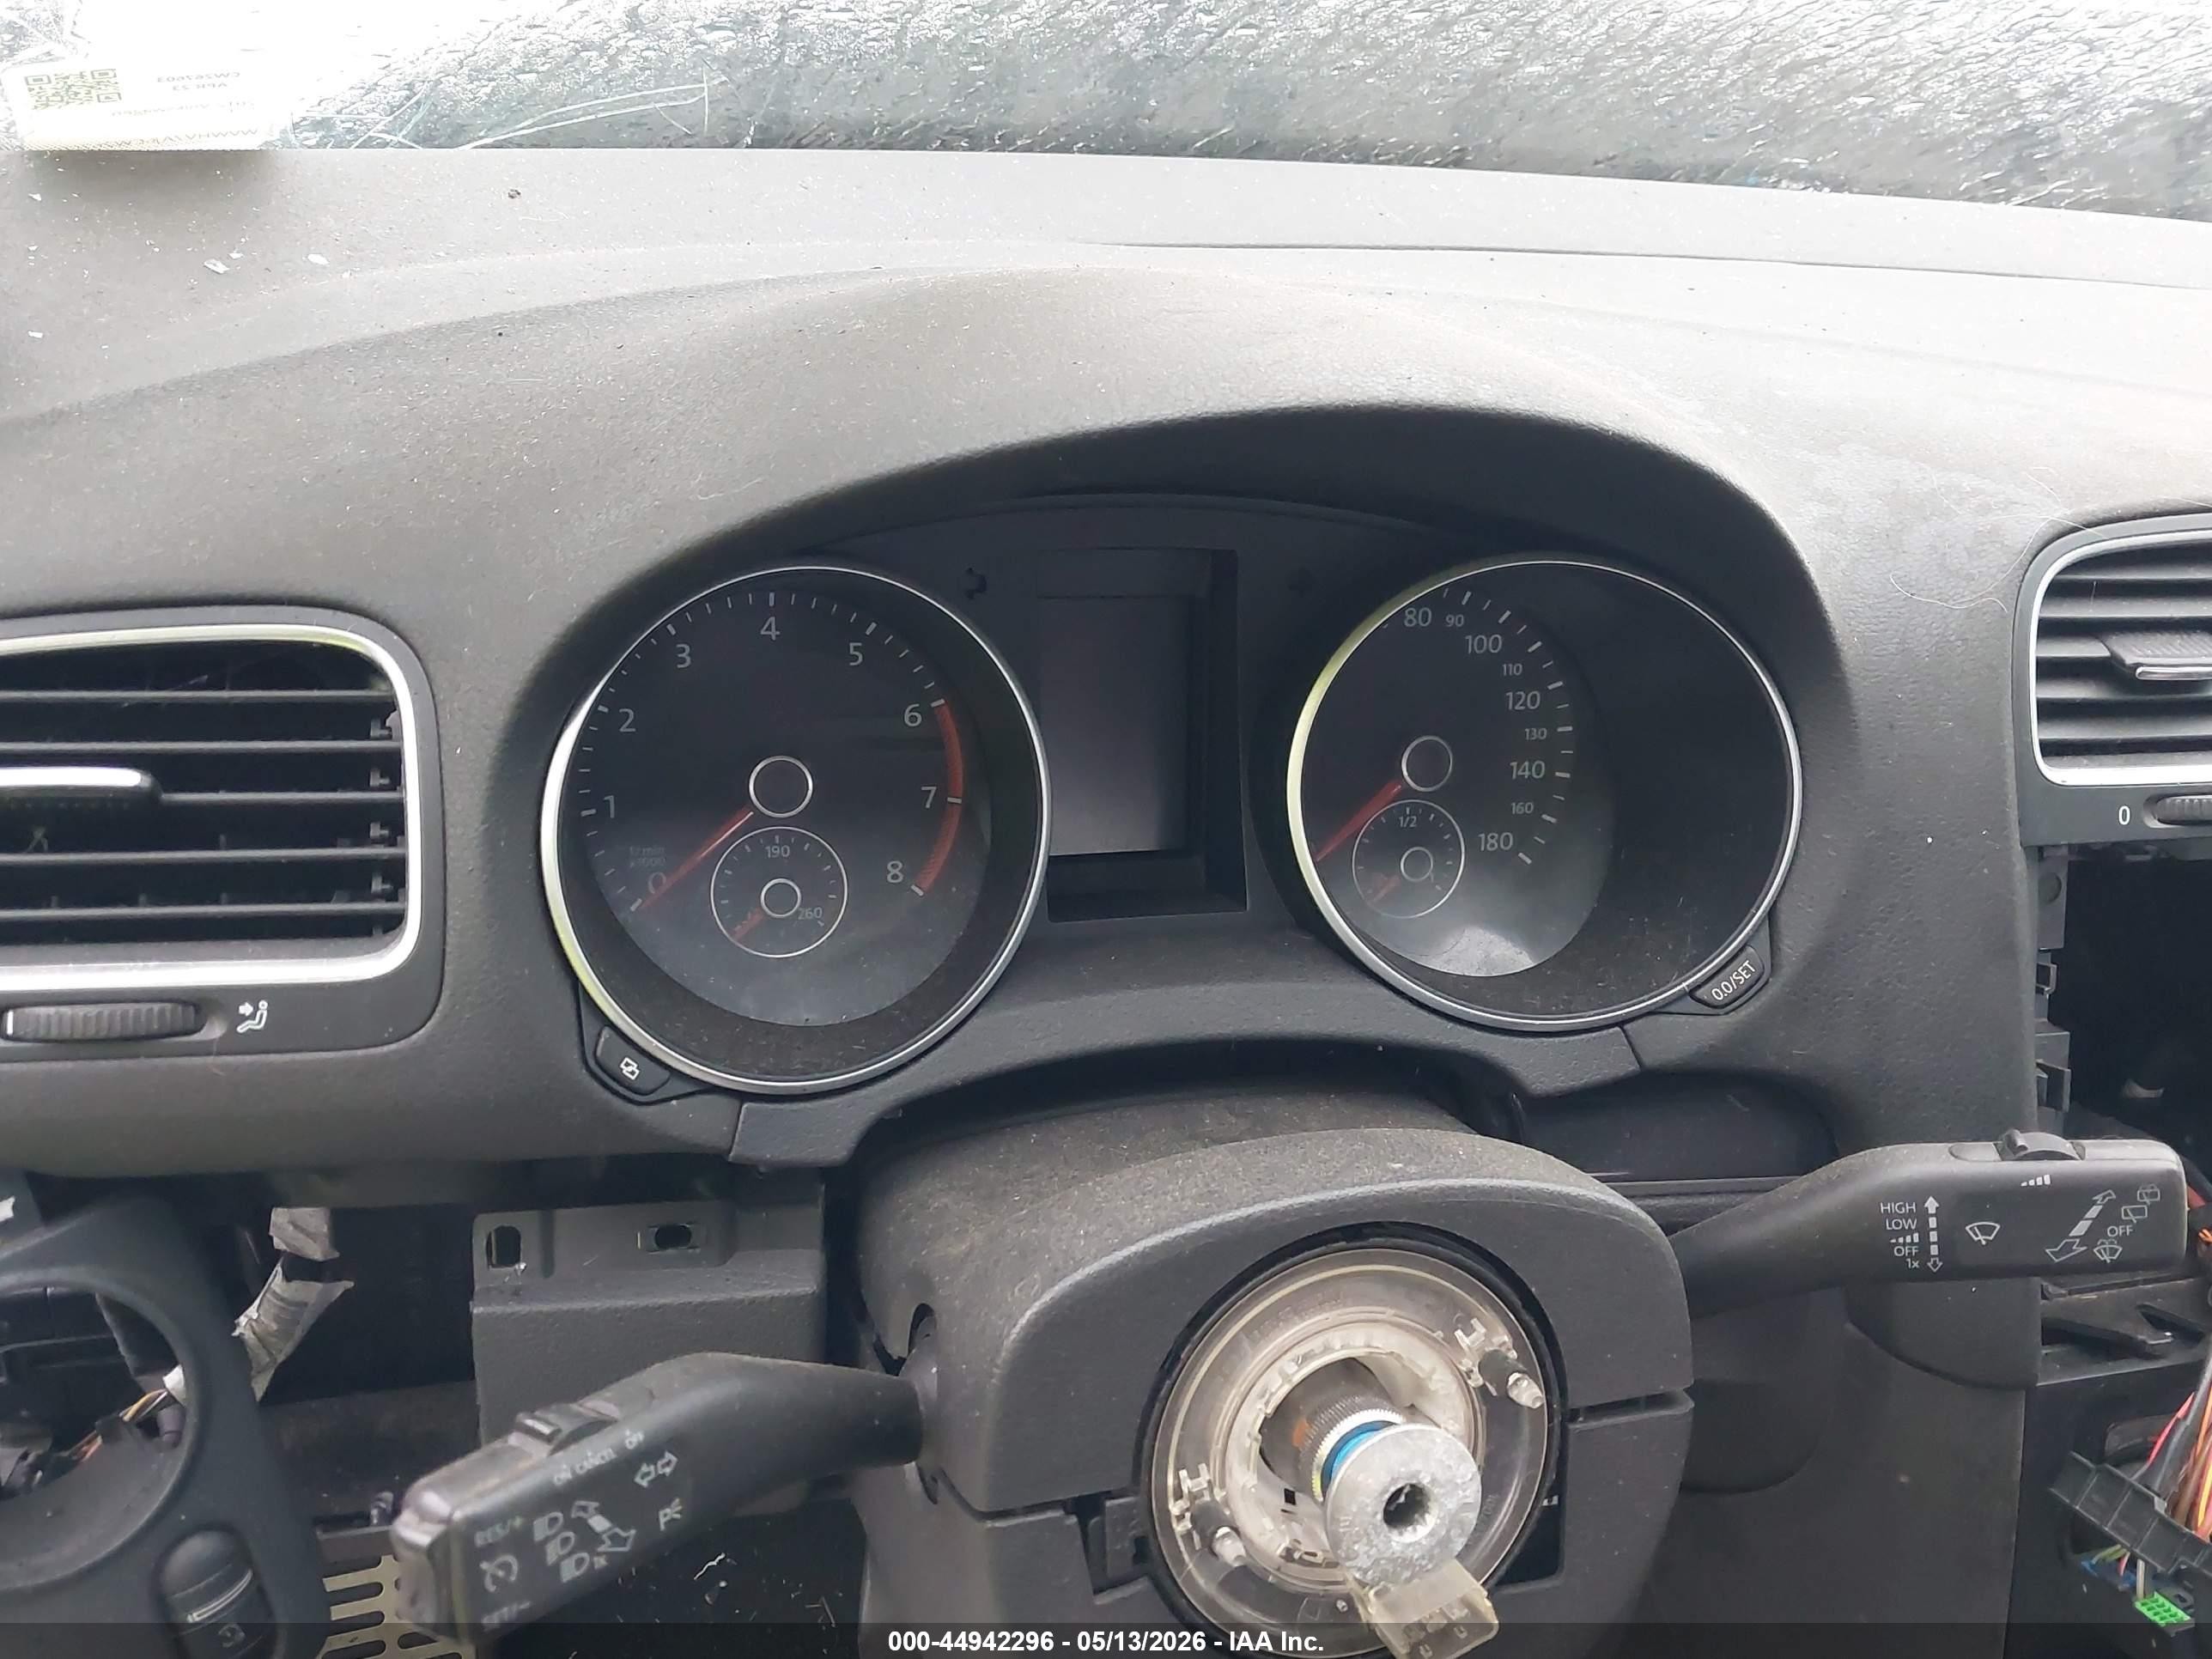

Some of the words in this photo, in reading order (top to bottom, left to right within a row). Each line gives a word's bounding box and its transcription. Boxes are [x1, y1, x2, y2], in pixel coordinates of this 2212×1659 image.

[1403, 607, 1432, 627] 80
[1445, 614, 1464, 627] 90
[760, 616, 781, 641] 4
[1465, 634, 1503, 653] 100
[675, 644, 692, 668] 3
[848, 642, 863, 666] 5
[1503, 663, 1522, 676] 110
[1505, 690, 1540, 710] 120
[618, 708, 636, 732] 2
[903, 703, 922, 727] 6
[1524, 727, 1547, 740] 130
[1510, 760, 1546, 780] 140
[603, 795, 615, 818] 1
[921, 786, 937, 809] 7
[1510, 802, 1534, 814] 160
[2118, 805, 2130, 825] 0
[1399, 816, 1417, 828] 1/2
[1478, 832, 1513, 851] 180
[765, 845, 790, 858] 190
[886, 860, 903, 884] 8
[798, 907, 823, 920] 260
[1711, 960, 1755, 1000] 0.0/SET
[1881, 1202, 1916, 1213] HIGH
[1886, 1218, 1917, 1230] LOW
[2107, 1224, 2135, 1237] OFF
[1894, 1245, 1918, 1256] OFF
[1906, 1258, 1919, 1268] 1x
